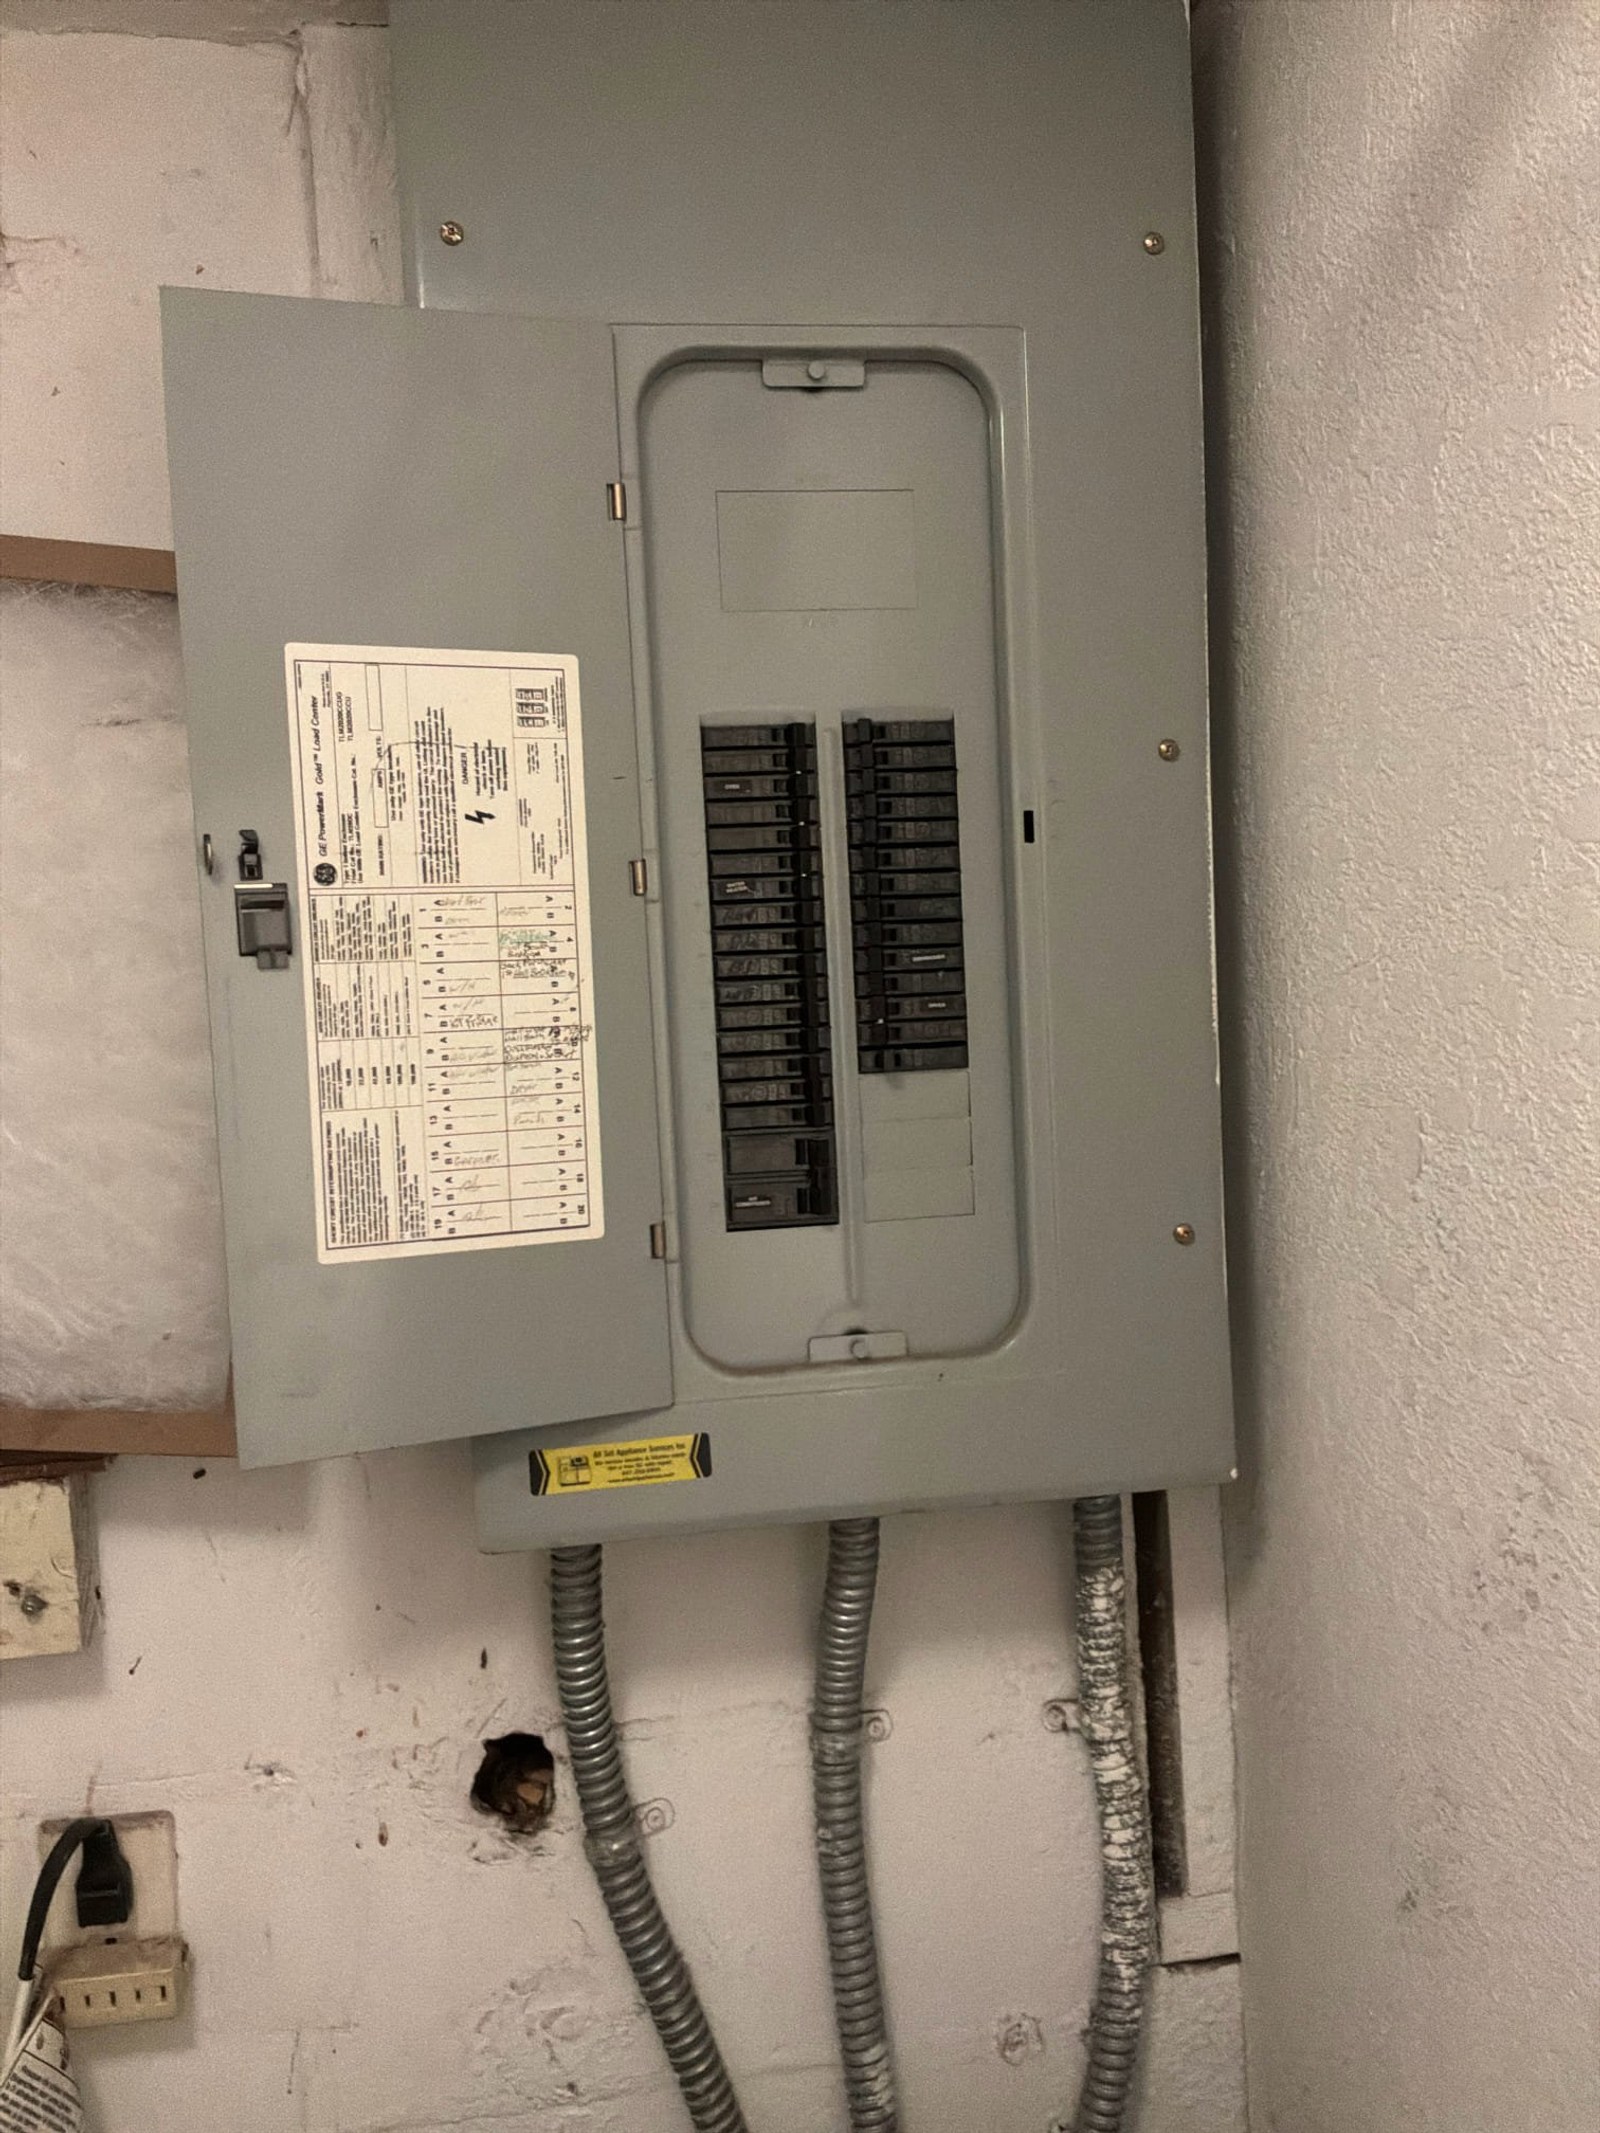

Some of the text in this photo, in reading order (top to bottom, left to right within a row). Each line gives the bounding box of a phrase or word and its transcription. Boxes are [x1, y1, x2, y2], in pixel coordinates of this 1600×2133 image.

[310, 695, 320, 725] Center
[311, 728, 321, 751] Load
[460, 752, 468, 784] DANGER
[315, 791, 326, 840] PowerMark
[318, 842, 327, 856] GE
[572, 1071, 579, 1081] 12
[427, 1082, 435, 1091] 11
[573, 1103, 581, 1113] 14
[429, 1115, 437, 1124] 13
[575, 1138, 582, 1147] 16
[431, 1150, 438, 1160] 15
[432, 1186, 440, 1196] 17
[578, 1204, 585, 1214] 20
[434, 1218, 442, 1228] 19
